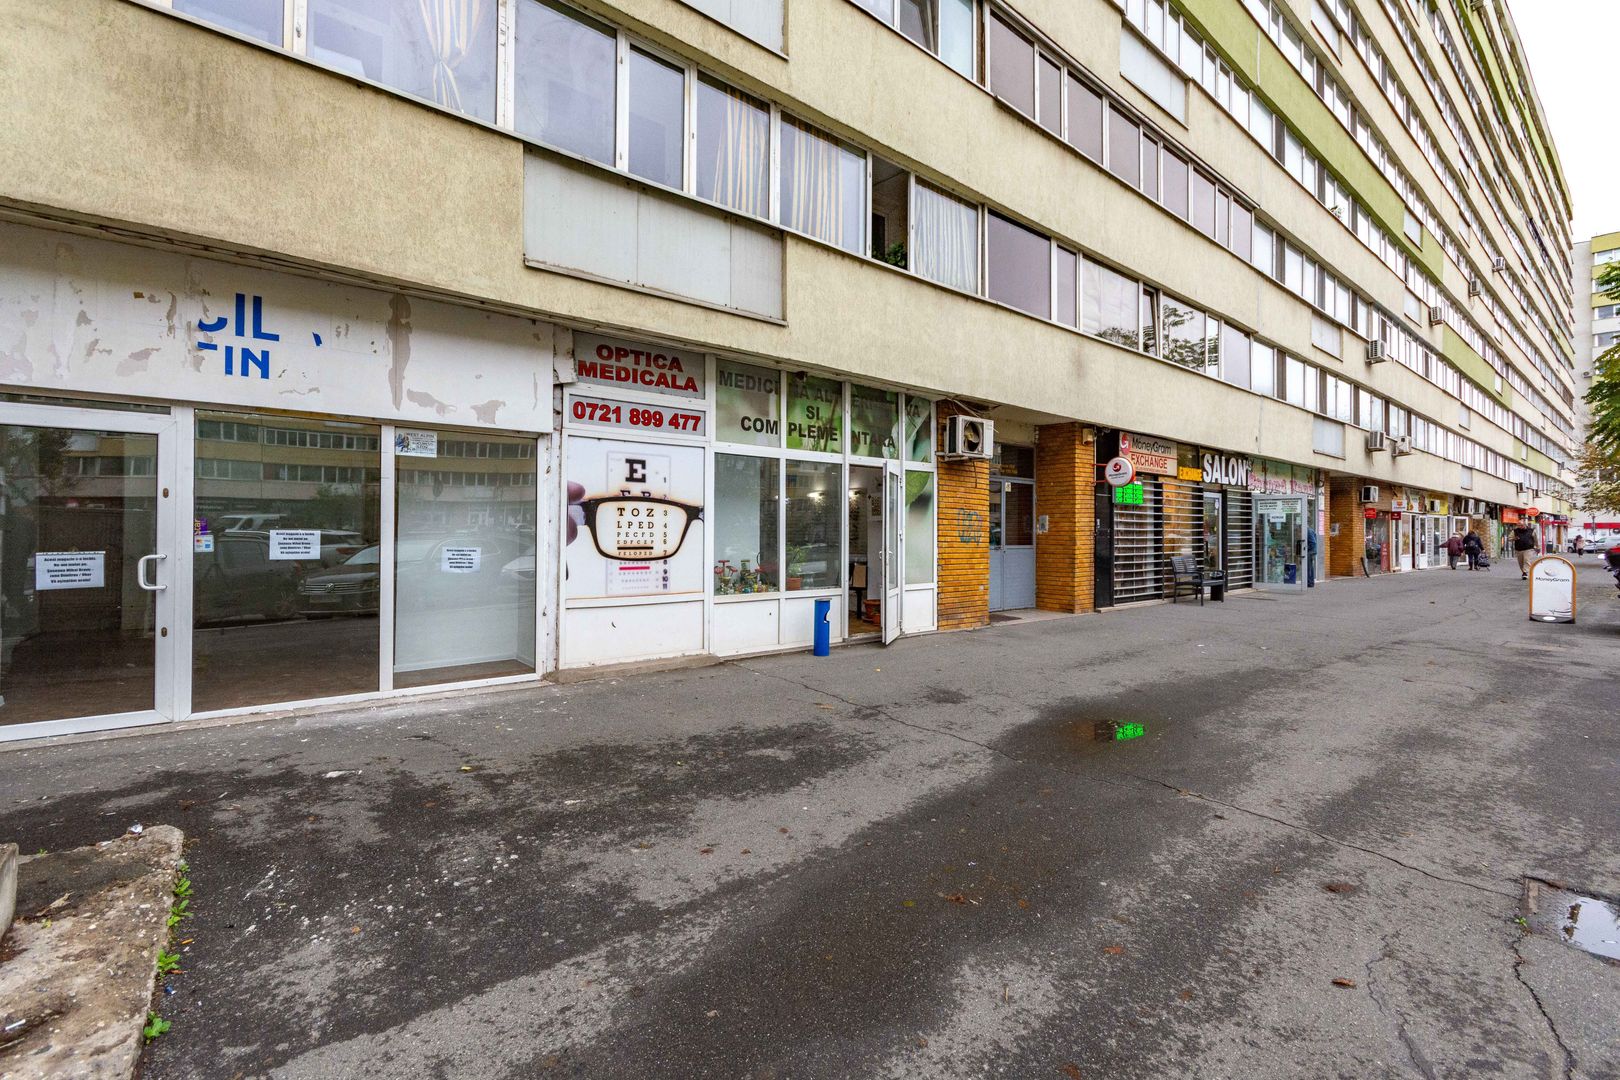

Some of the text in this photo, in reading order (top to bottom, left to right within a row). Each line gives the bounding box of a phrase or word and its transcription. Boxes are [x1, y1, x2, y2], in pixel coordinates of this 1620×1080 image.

[596, 344, 683, 373] OPTICA
[578, 359, 699, 392] MEDICALA
[572, 401, 702, 432] 0721 899 477
[806, 405, 820, 421] SI
[1132, 437, 1172, 455] MoneyGram
[625, 458, 646, 483] E
[1131, 454, 1168, 469] EXCHANGE
[1203, 453, 1247, 486] SALON
